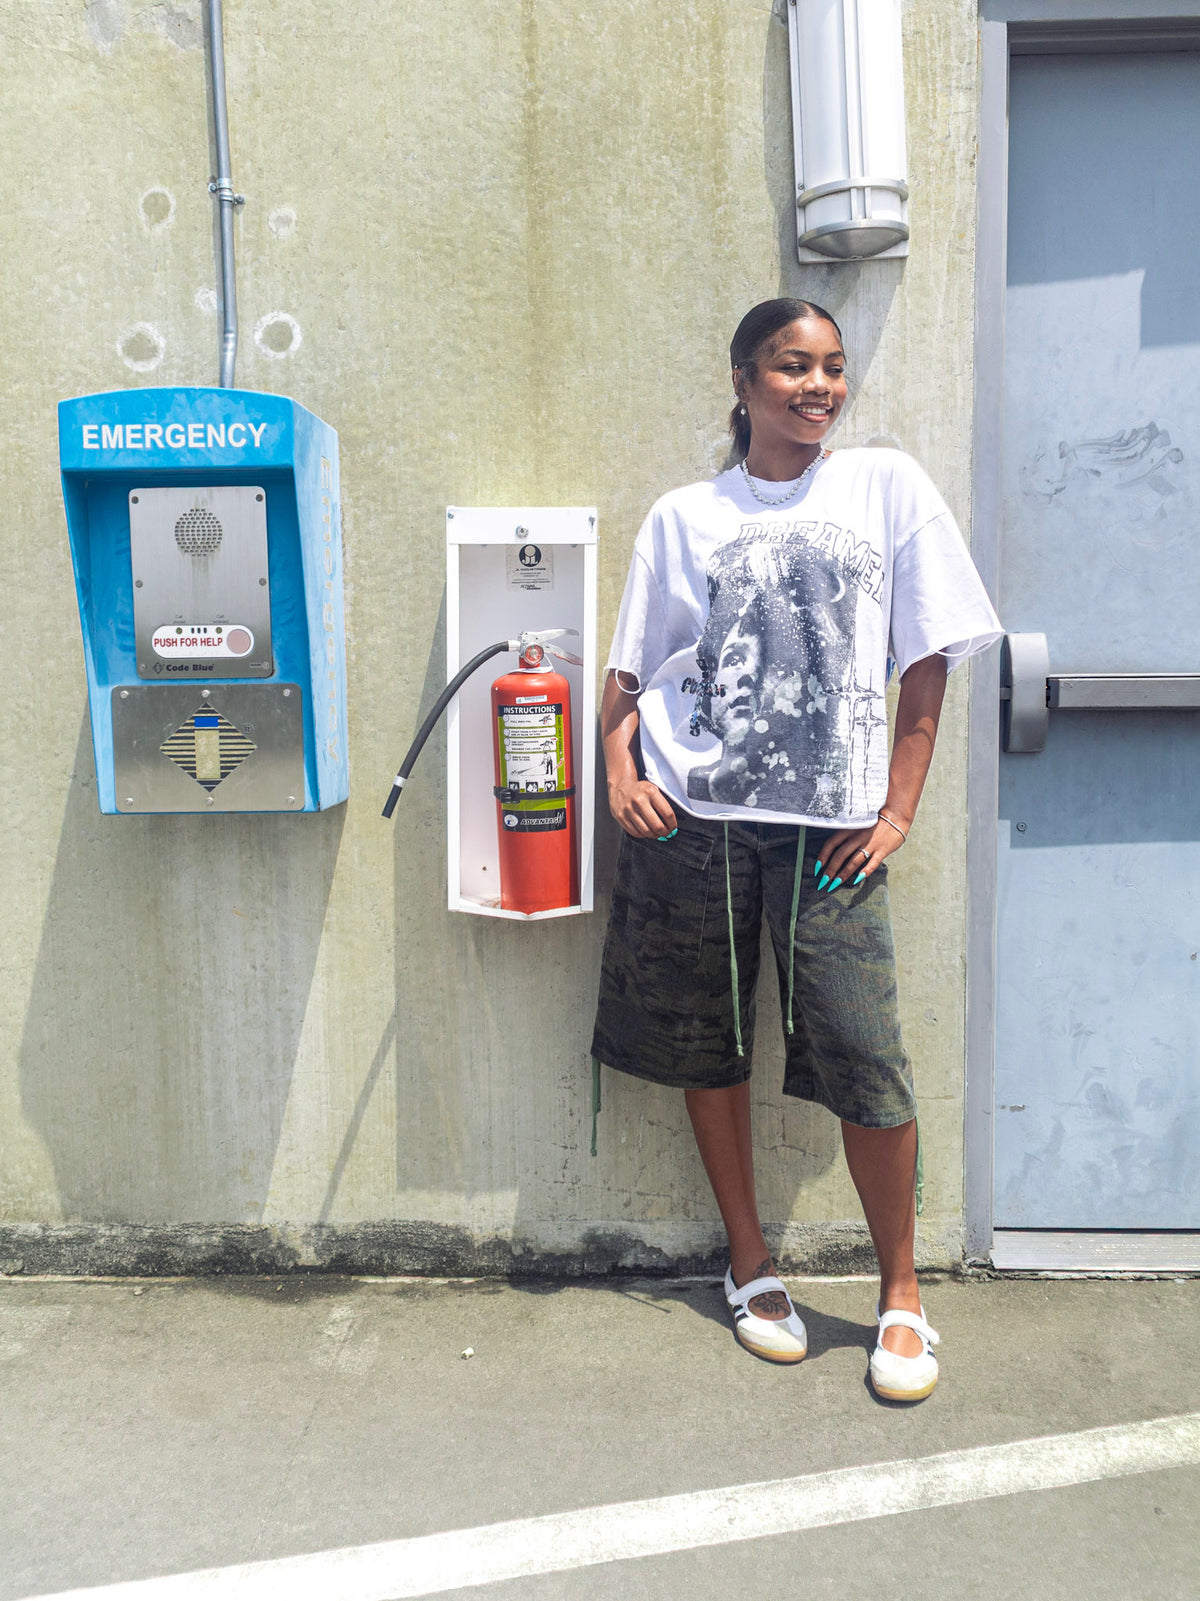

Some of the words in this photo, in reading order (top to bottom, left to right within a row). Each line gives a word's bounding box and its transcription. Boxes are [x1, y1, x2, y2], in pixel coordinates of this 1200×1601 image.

[82, 422, 267, 449] EMERGENCY
[154, 638, 178, 647] PUSH
[180, 637, 198, 647] FOR
[200, 637, 223, 646] HELP
[166, 664, 189, 672] Code
[503, 705, 556, 714] INSTRUCTIONS
